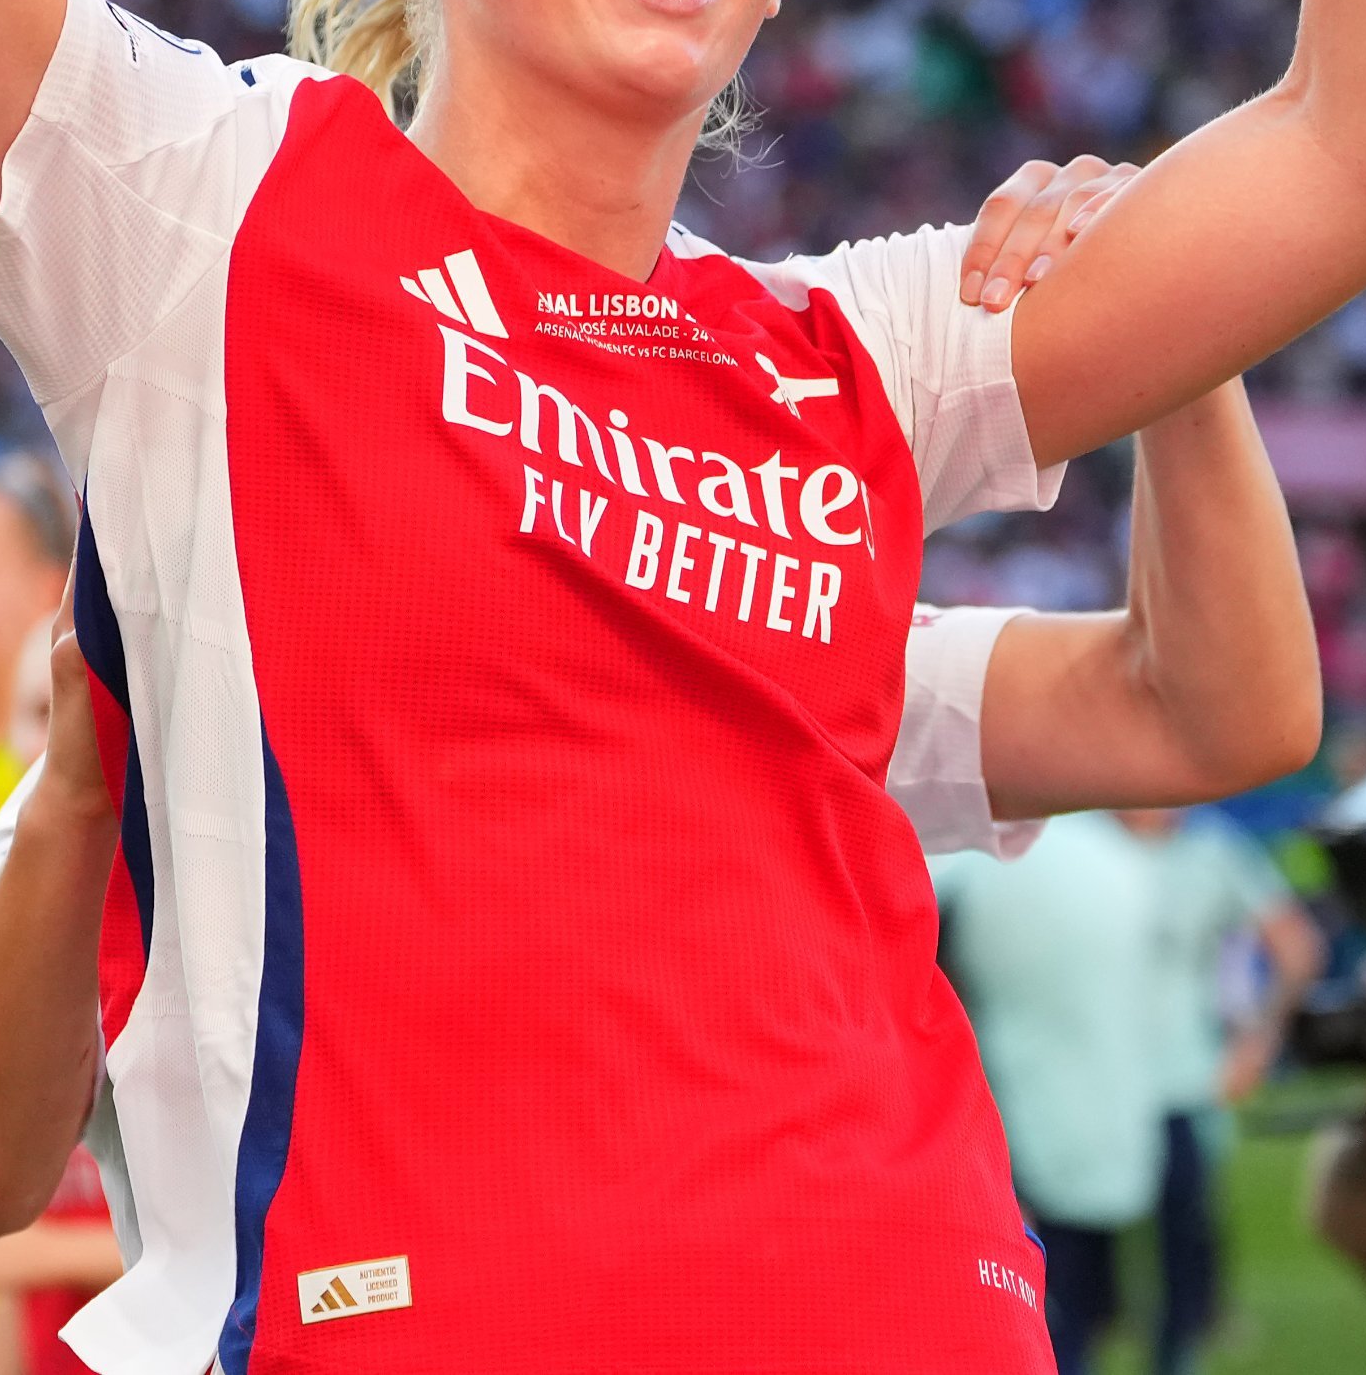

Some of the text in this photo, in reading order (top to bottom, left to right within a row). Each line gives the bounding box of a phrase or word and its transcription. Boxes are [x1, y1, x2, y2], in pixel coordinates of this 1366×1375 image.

[537, 292, 584, 317] NAL
[589, 293, 678, 320] LISBON
[535, 321, 585, 342] ARSENAL
[622, 344, 636, 357] FC
[652, 346, 666, 358] FC
[610, 322, 680, 339] ALVALADE
[691, 327, 709, 342] 24
[519, 464, 842, 645] FLY BETTER
[367, 1291, 398, 1305] PRODUCT
